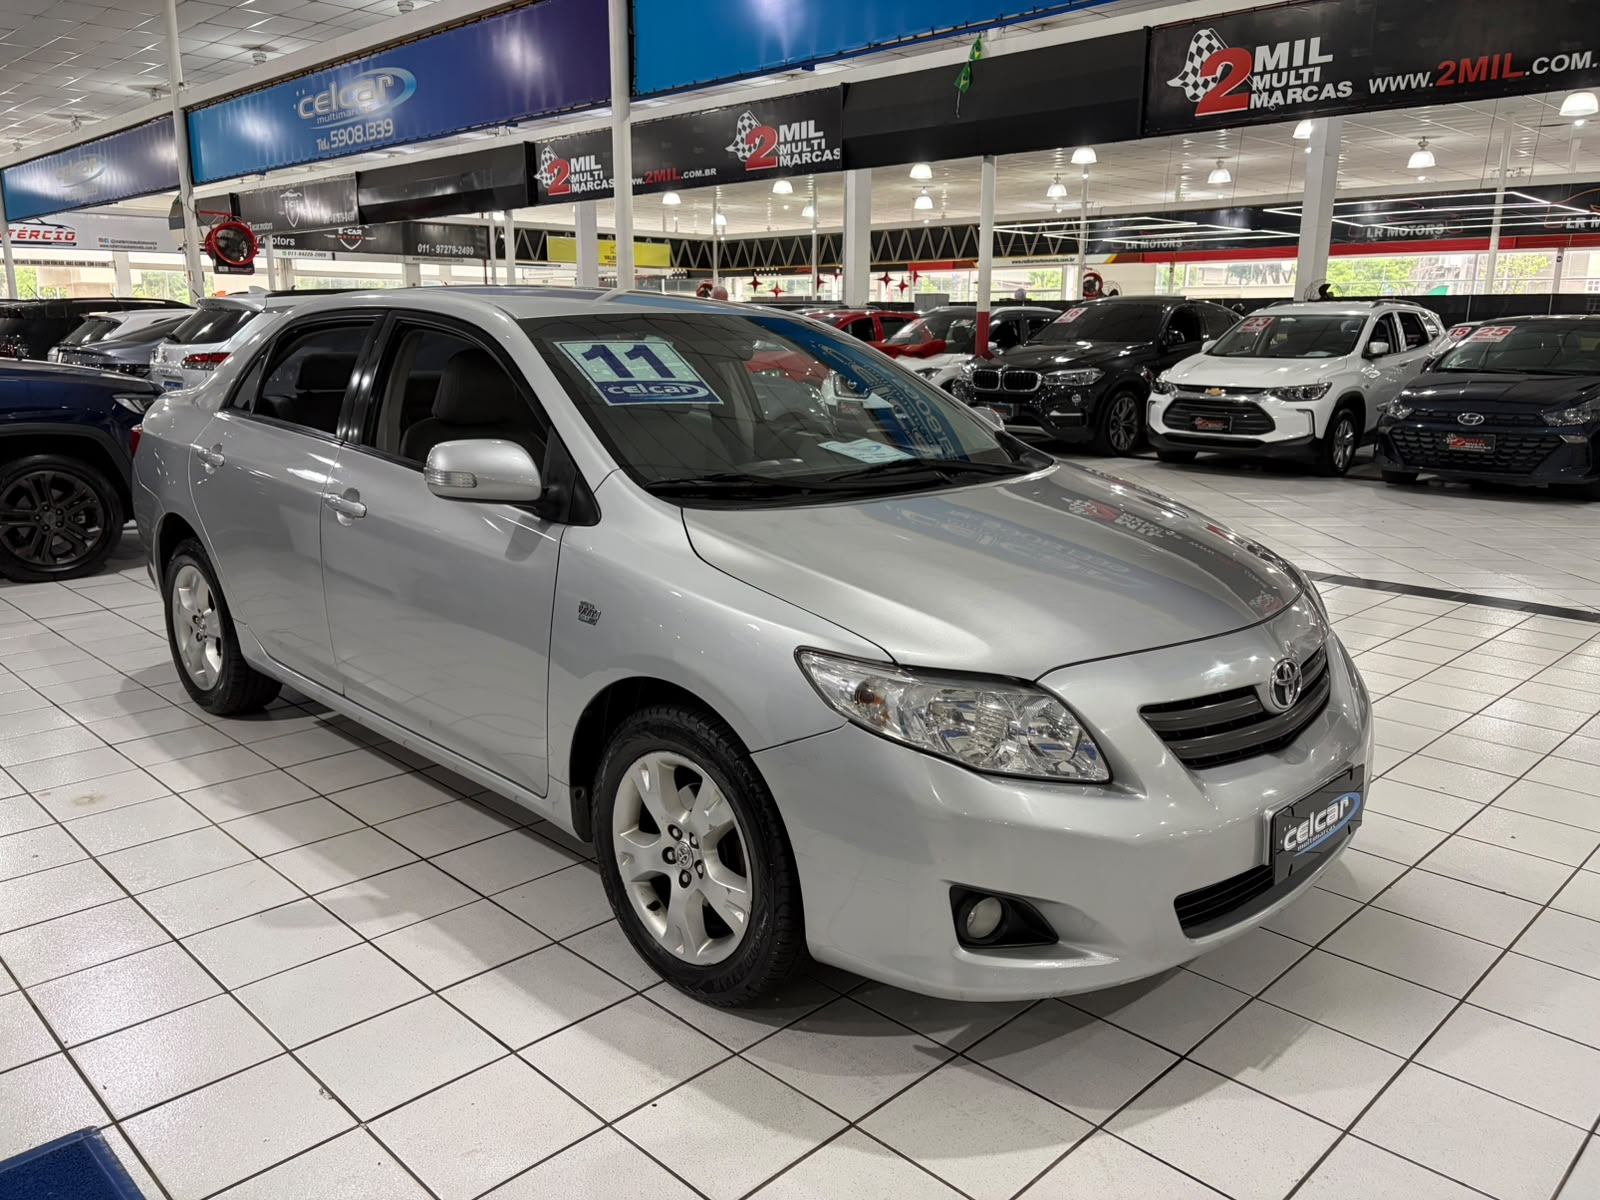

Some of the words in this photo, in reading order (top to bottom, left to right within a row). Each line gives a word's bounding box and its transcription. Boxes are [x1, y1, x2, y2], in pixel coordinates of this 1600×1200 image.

[1195, 47, 1254, 116] 2
[1253, 36, 1334, 73] MIL
[1252, 66, 1321, 92] MULTI
[297, 74, 395, 120] celcar
[1250, 81, 1353, 109] MARCAS
[330, 118, 394, 148] 5908.1339
[745, 126, 778, 171] 2
[779, 120, 824, 142] MIL
[780, 138, 826, 155] MULTI
[780, 148, 840, 168] MARCAS
[548, 159, 571, 195] 2
[570, 155, 602, 172] MIL
[571, 171, 604, 184] MULTI
[571, 178, 615, 193] MARCAS
[8, 227, 77, 241] TÉRCIO
[1366, 227, 1384, 239] LR
[1387, 223, 1445, 238] MOTORS
[417, 244, 430, 254] 011
[1474, 326, 1514, 337] 25
[581, 344, 676, 379] 11
[607, 383, 693, 394] celcar
[1284, 796, 1350, 852] celcar
